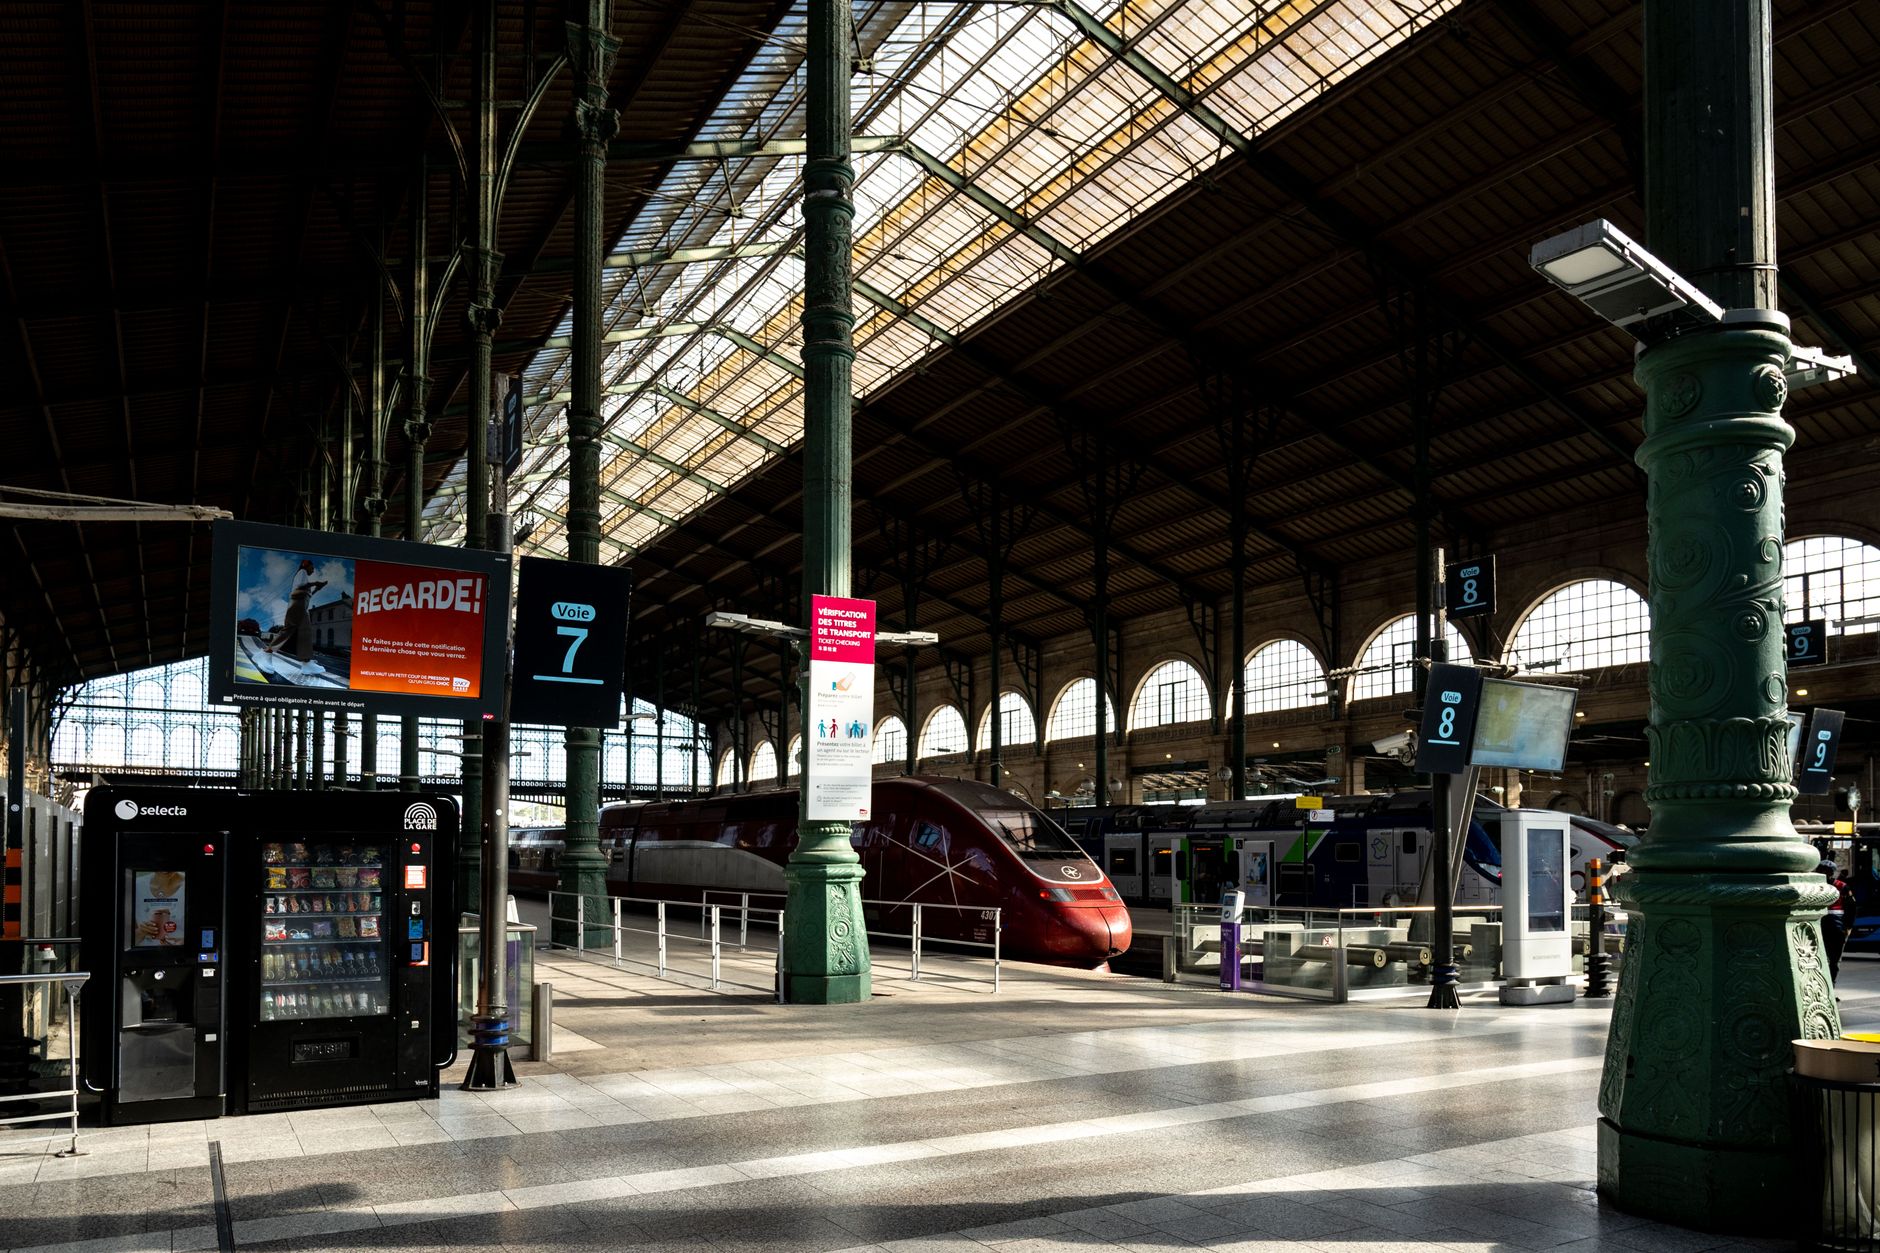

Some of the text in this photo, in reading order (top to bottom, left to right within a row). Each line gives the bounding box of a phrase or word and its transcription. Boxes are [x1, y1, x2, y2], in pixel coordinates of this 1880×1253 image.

[1462, 568, 1478, 577] Voie
[357, 578, 483, 615] REGARDE!
[1463, 579, 1478, 603] 8
[557, 604, 590, 620] Voie
[818, 607, 867, 619] VÉRIFICATION
[818, 618, 857, 628] DES TITRES
[829, 628, 871, 639] TRANSPORT
[369, 646, 397, 654] dernière
[373, 638, 391, 646] faites
[392, 640, 404, 648] pas
[414, 641, 430, 649] cette
[431, 642, 466, 652] notification
[556, 626, 589, 673] 7
[1794, 636, 1809, 656] 9
[264, 695, 277, 703] quai
[346, 700, 365, 708] départ
[1443, 692, 1459, 703] Voie
[1438, 706, 1456, 738] 8
[1814, 742, 1827, 767] 9
[140, 805, 188, 816] selecta
